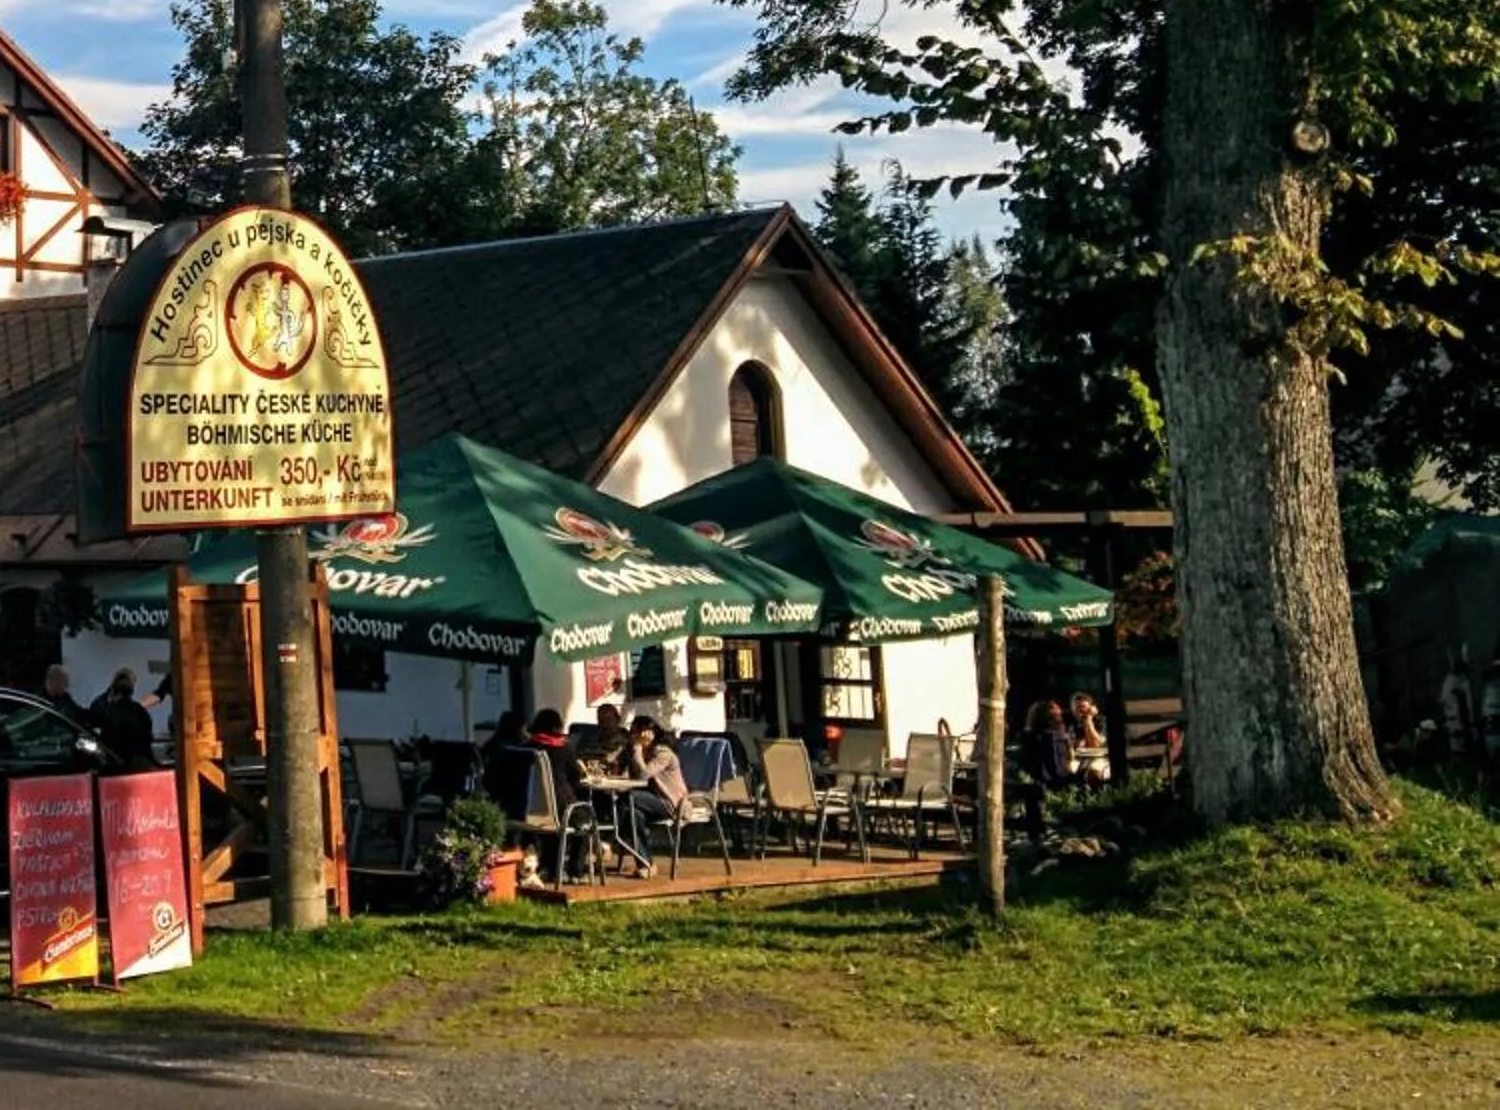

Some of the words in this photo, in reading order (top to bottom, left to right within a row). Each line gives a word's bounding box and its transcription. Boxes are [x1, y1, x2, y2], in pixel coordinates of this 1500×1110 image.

[151, 240, 223, 342] Hostinec
[227, 230, 240, 248] u
[246, 217, 306, 250] pejska
[310, 243, 321, 261] a
[140, 392, 250, 415] SPECIALITY
[187, 421, 296, 445] BÖHMISCHE
[301, 419, 352, 443] KÜCHE
[141, 455, 253, 483] UBYTOVÁNÍ
[337, 455, 361, 483] Kč
[141, 487, 274, 512] UNTERKUNFT
[110, 603, 169, 628] Chodov
